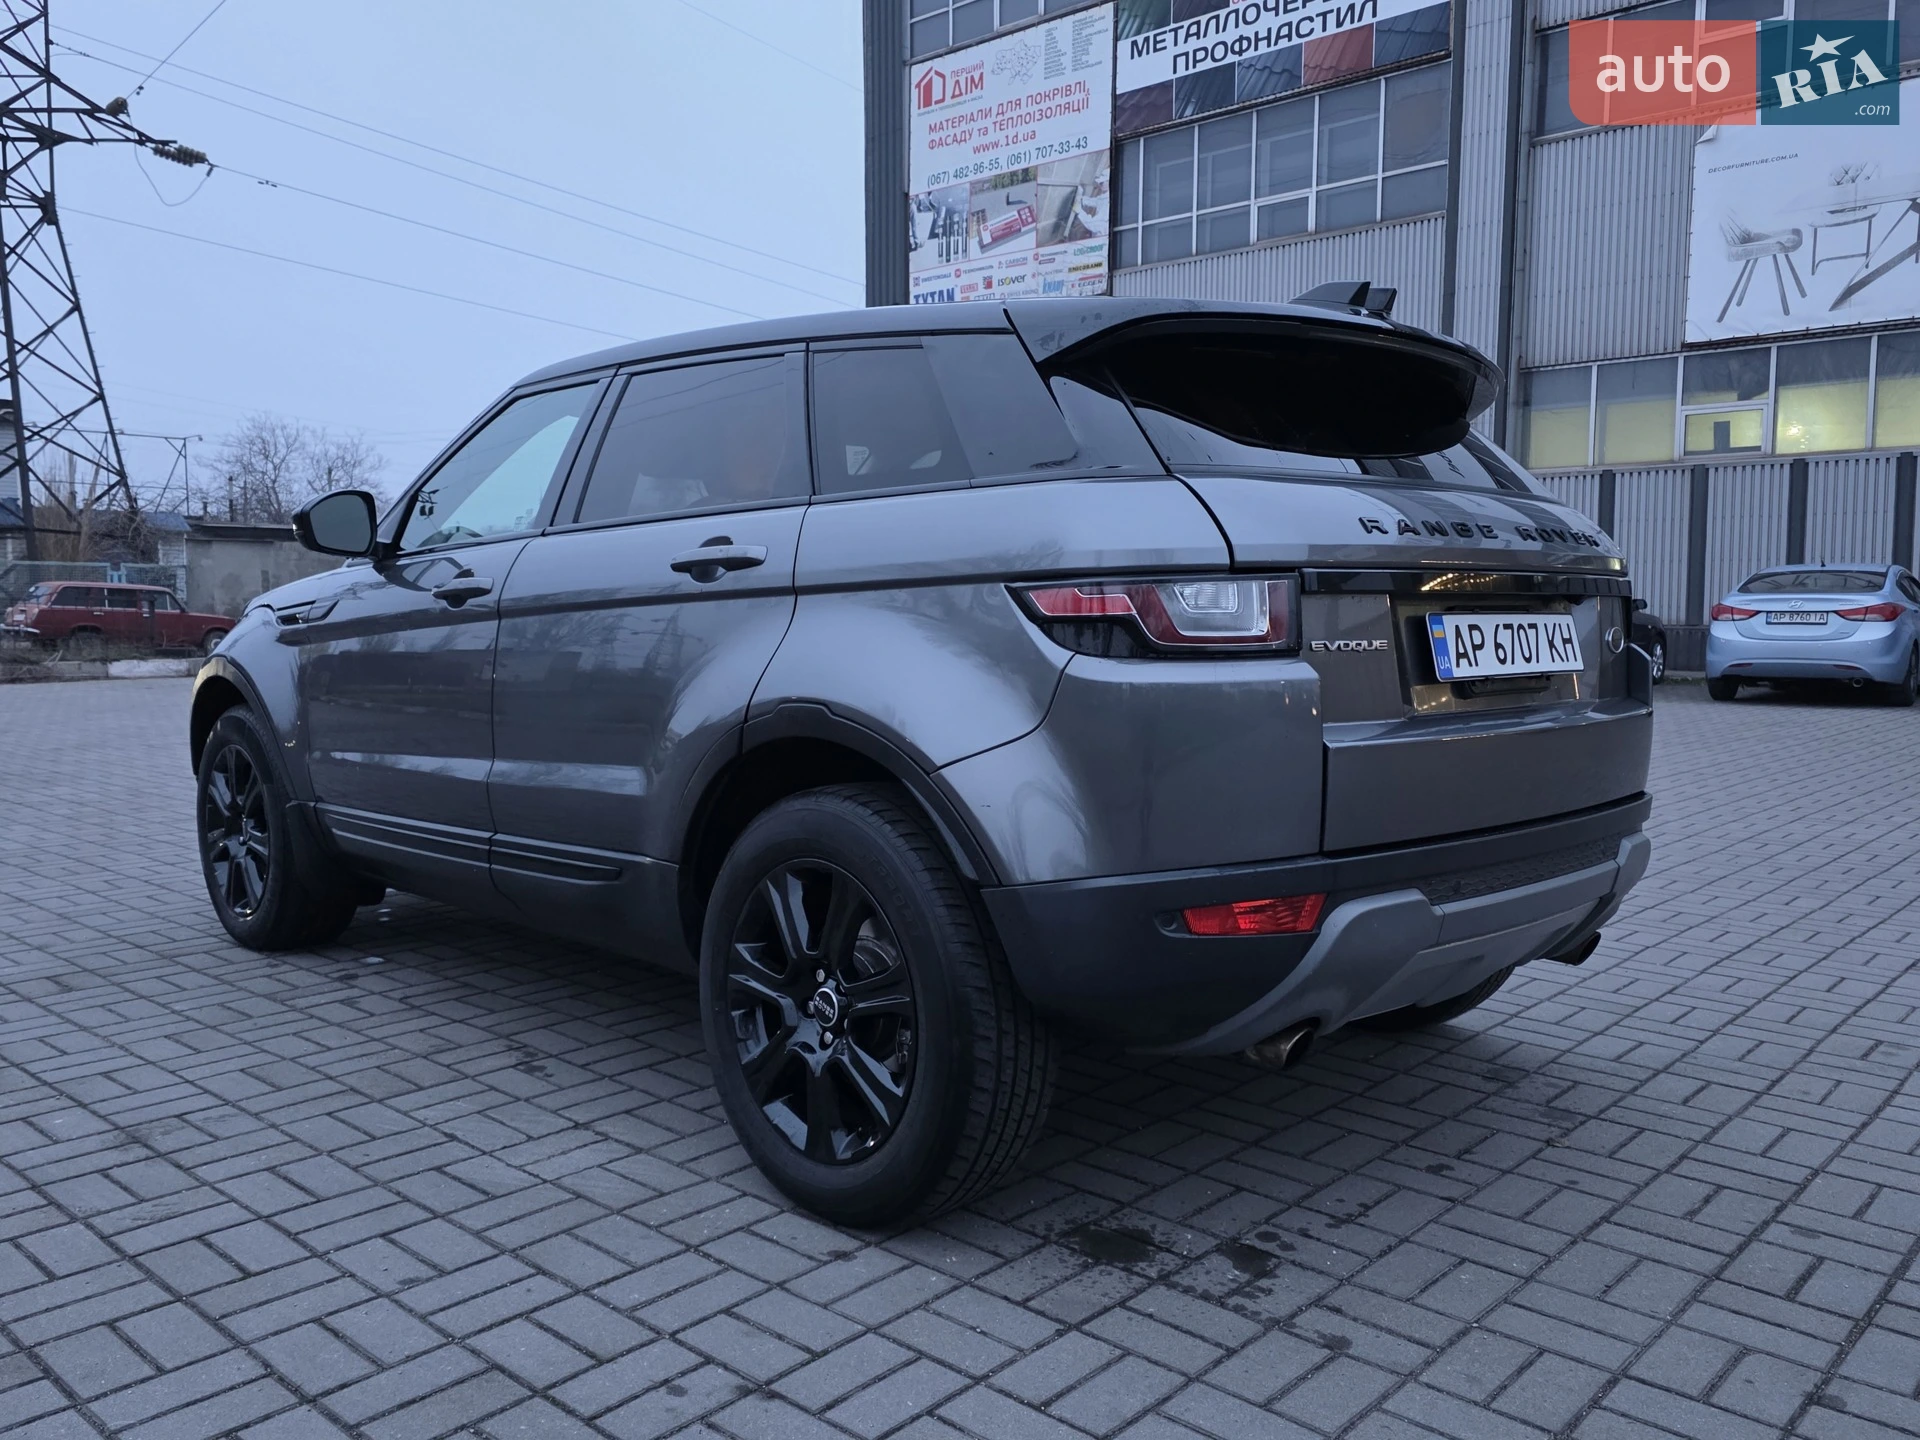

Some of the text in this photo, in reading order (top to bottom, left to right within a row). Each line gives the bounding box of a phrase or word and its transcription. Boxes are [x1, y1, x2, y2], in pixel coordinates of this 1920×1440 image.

[1130, 0, 1333, 60] МЕТАЛЛОЧЕ
[1172, 0, 1378, 75] ПРОФНАСТИЛ
[951, 60, 985, 79] ПЕРШИЙ
[950, 72, 984, 100] ДІМ
[928, 106, 993, 135] МАТЕРІАЛИ
[995, 98, 1022, 120] ДЛЯ
[928, 127, 975, 150] ФАСАДУ
[977, 126, 989, 138] та
[992, 94, 1089, 132] ТЕПЛОІЗОЛЯЦІЇ
[972, 130, 1037, 154] www.1d.ua
[927, 136, 1088, 189] (067) 482-96-55, (061) 707-33-43
[1707, 153, 1799, 174] DECORFURNITURE.COM.UA
[1358, 516, 1601, 548] RANGE ROVER
[1772, 613, 1786, 622] AP
[1789, 613, 1811, 622] 8760
[1311, 639, 1389, 653] EVOQUE
[1454, 622, 1578, 668] AP 6707 KH
[1437, 655, 1451, 670] UA
